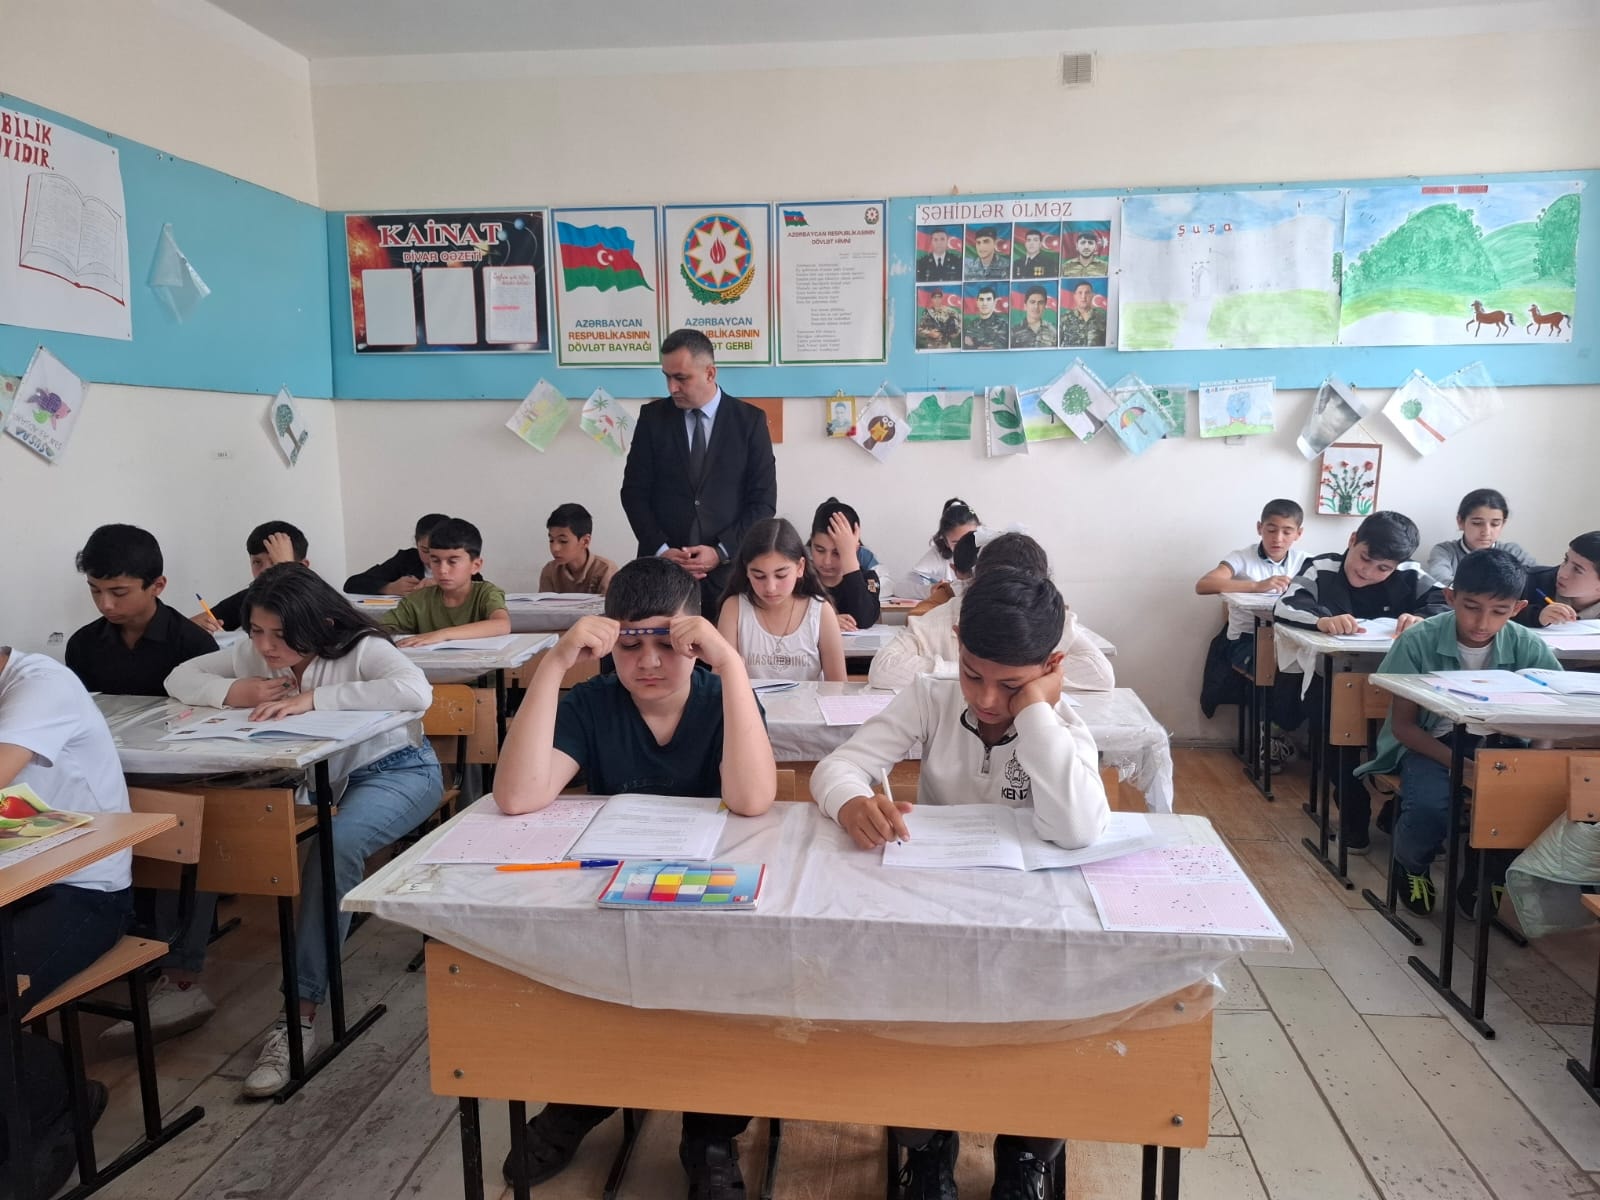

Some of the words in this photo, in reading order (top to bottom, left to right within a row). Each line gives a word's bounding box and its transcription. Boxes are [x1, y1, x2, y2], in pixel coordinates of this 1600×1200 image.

[1, 112, 52, 146] BİLİK
[921, 202, 1004, 223] ŞƏHİDLƏR
[1012, 200, 1072, 217] ÖLMƏZ
[377, 219, 503, 248] KAİNAT
[403, 249, 439, 263] DİVAR
[575, 319, 643, 328] AZƏRBAYCAN
[685, 317, 753, 327] AZƏRBAYCAN
[568, 330, 650, 340] RESPUBLİKASININ
[702, 328, 760, 338] BLİKASININ
[568, 342, 606, 352] DÖVLƏT
[609, 341, 652, 352] BAYRAĞI
[725, 340, 753, 350] GERBİ
[1001, 786, 1029, 801] KENZ
